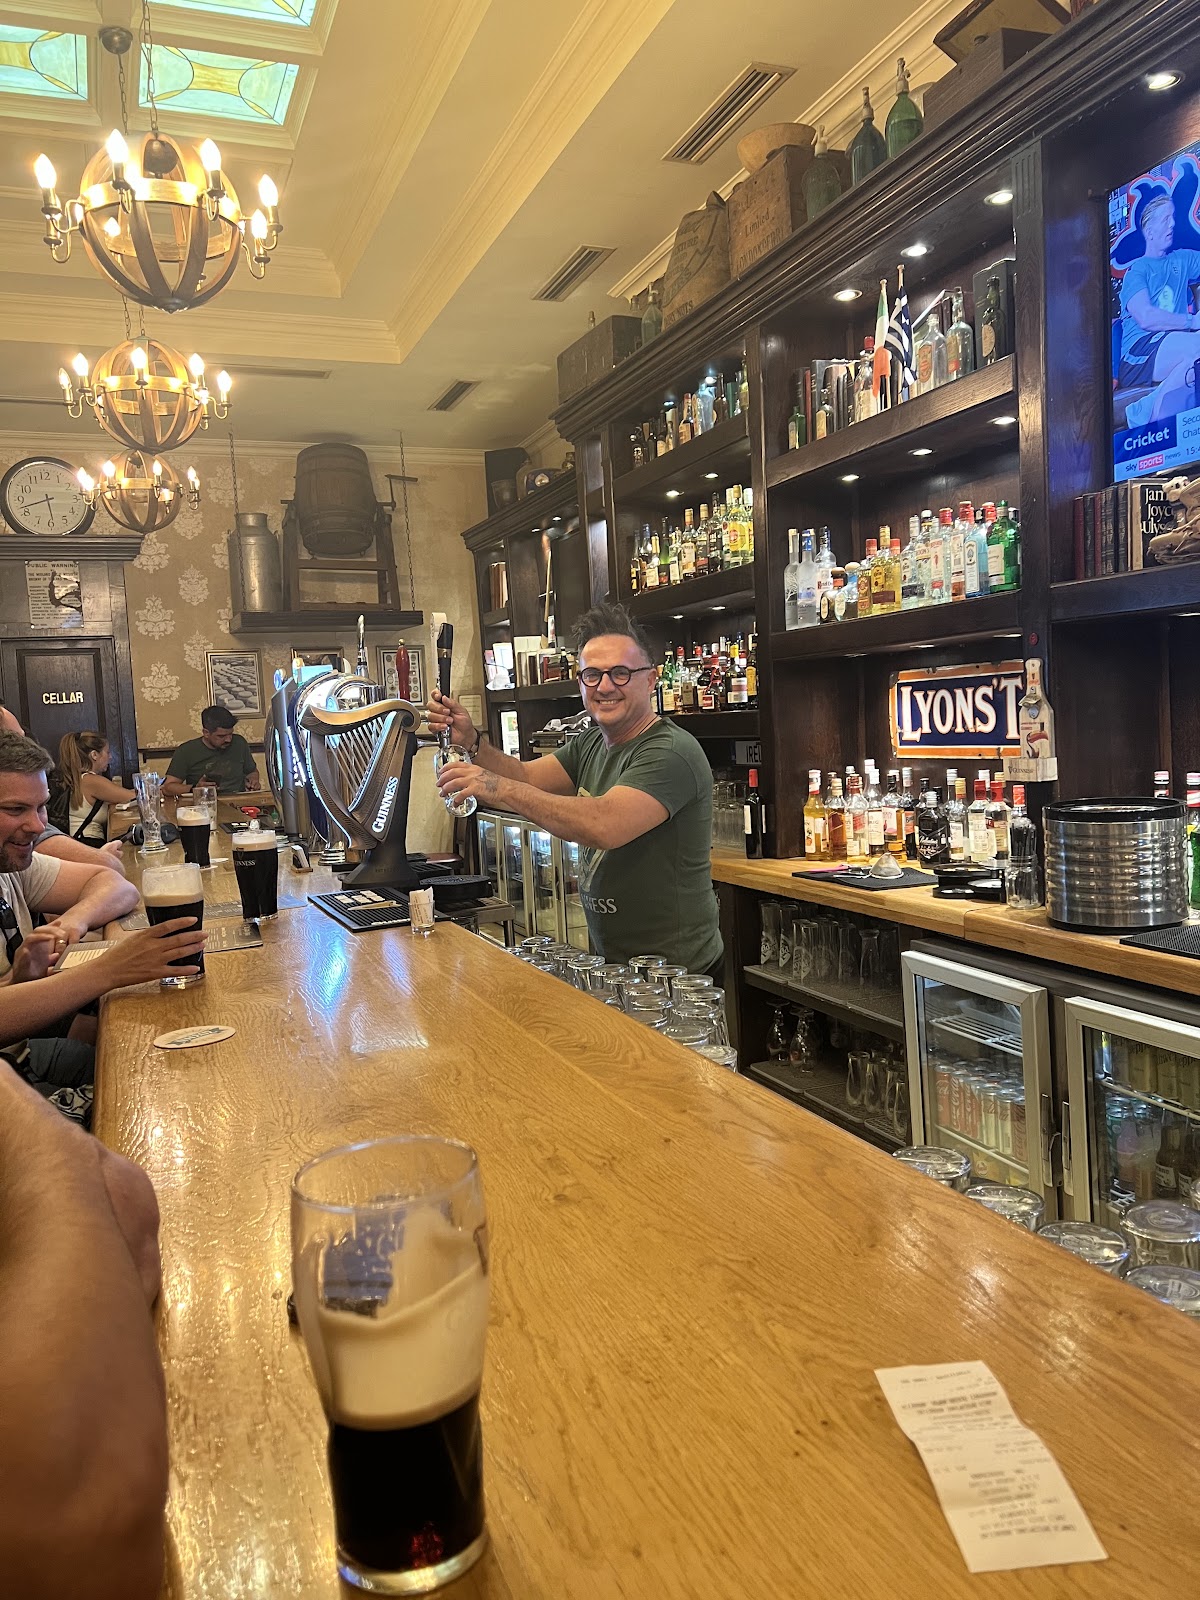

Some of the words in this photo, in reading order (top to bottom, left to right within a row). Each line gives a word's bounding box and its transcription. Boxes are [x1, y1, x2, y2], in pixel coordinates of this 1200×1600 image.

[1123, 427, 1170, 451] Cricket
[1125, 463, 1138, 472] sky
[1138, 455, 1163, 470] sports
[1165, 452, 1181, 460] news
[29, 475, 38, 484] 11
[56, 475, 60, 483] 1
[39, 471, 51, 480] 12
[21, 485, 32, 494] 10
[65, 483, 72, 491] 2
[17, 496, 25, 505] 9
[72, 495, 79, 503] 3
[23, 508, 31, 516] 8
[69, 507, 75, 515] 4
[35, 516, 41, 525] 7
[62, 516, 68, 524] 5
[47, 519, 55, 528] 6
[42, 691, 84, 704] CELLAR
[372, 776, 399, 833] GUINNESS
